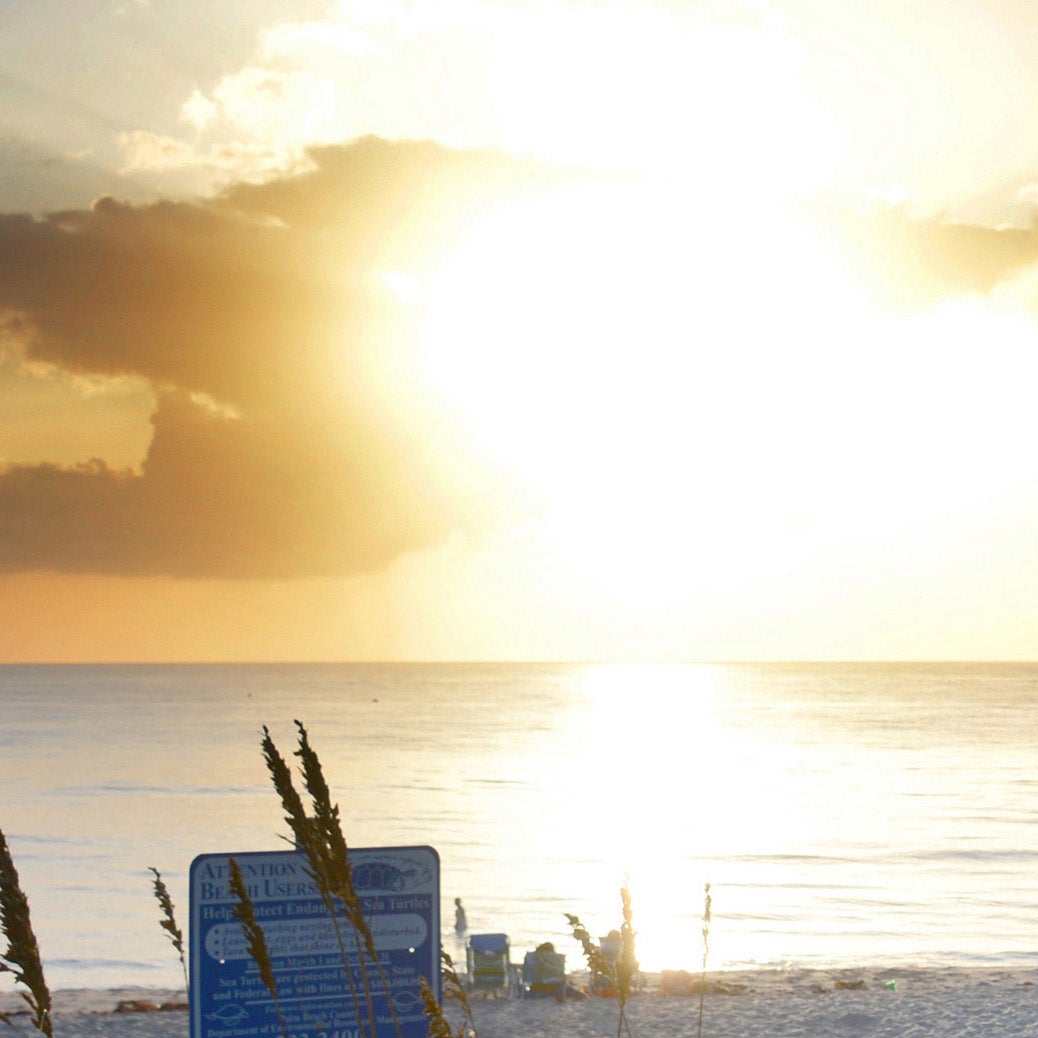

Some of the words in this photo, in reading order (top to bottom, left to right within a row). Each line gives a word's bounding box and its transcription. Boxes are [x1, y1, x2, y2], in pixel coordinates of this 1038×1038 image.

[200, 862, 297, 880] ATNTION
[201, 882, 258, 900] BEH
[264, 880, 316, 898] USERS
[203, 906, 232, 921] Help
[364, 899, 385, 911] Sea
[391, 896, 432, 910] Turtles
